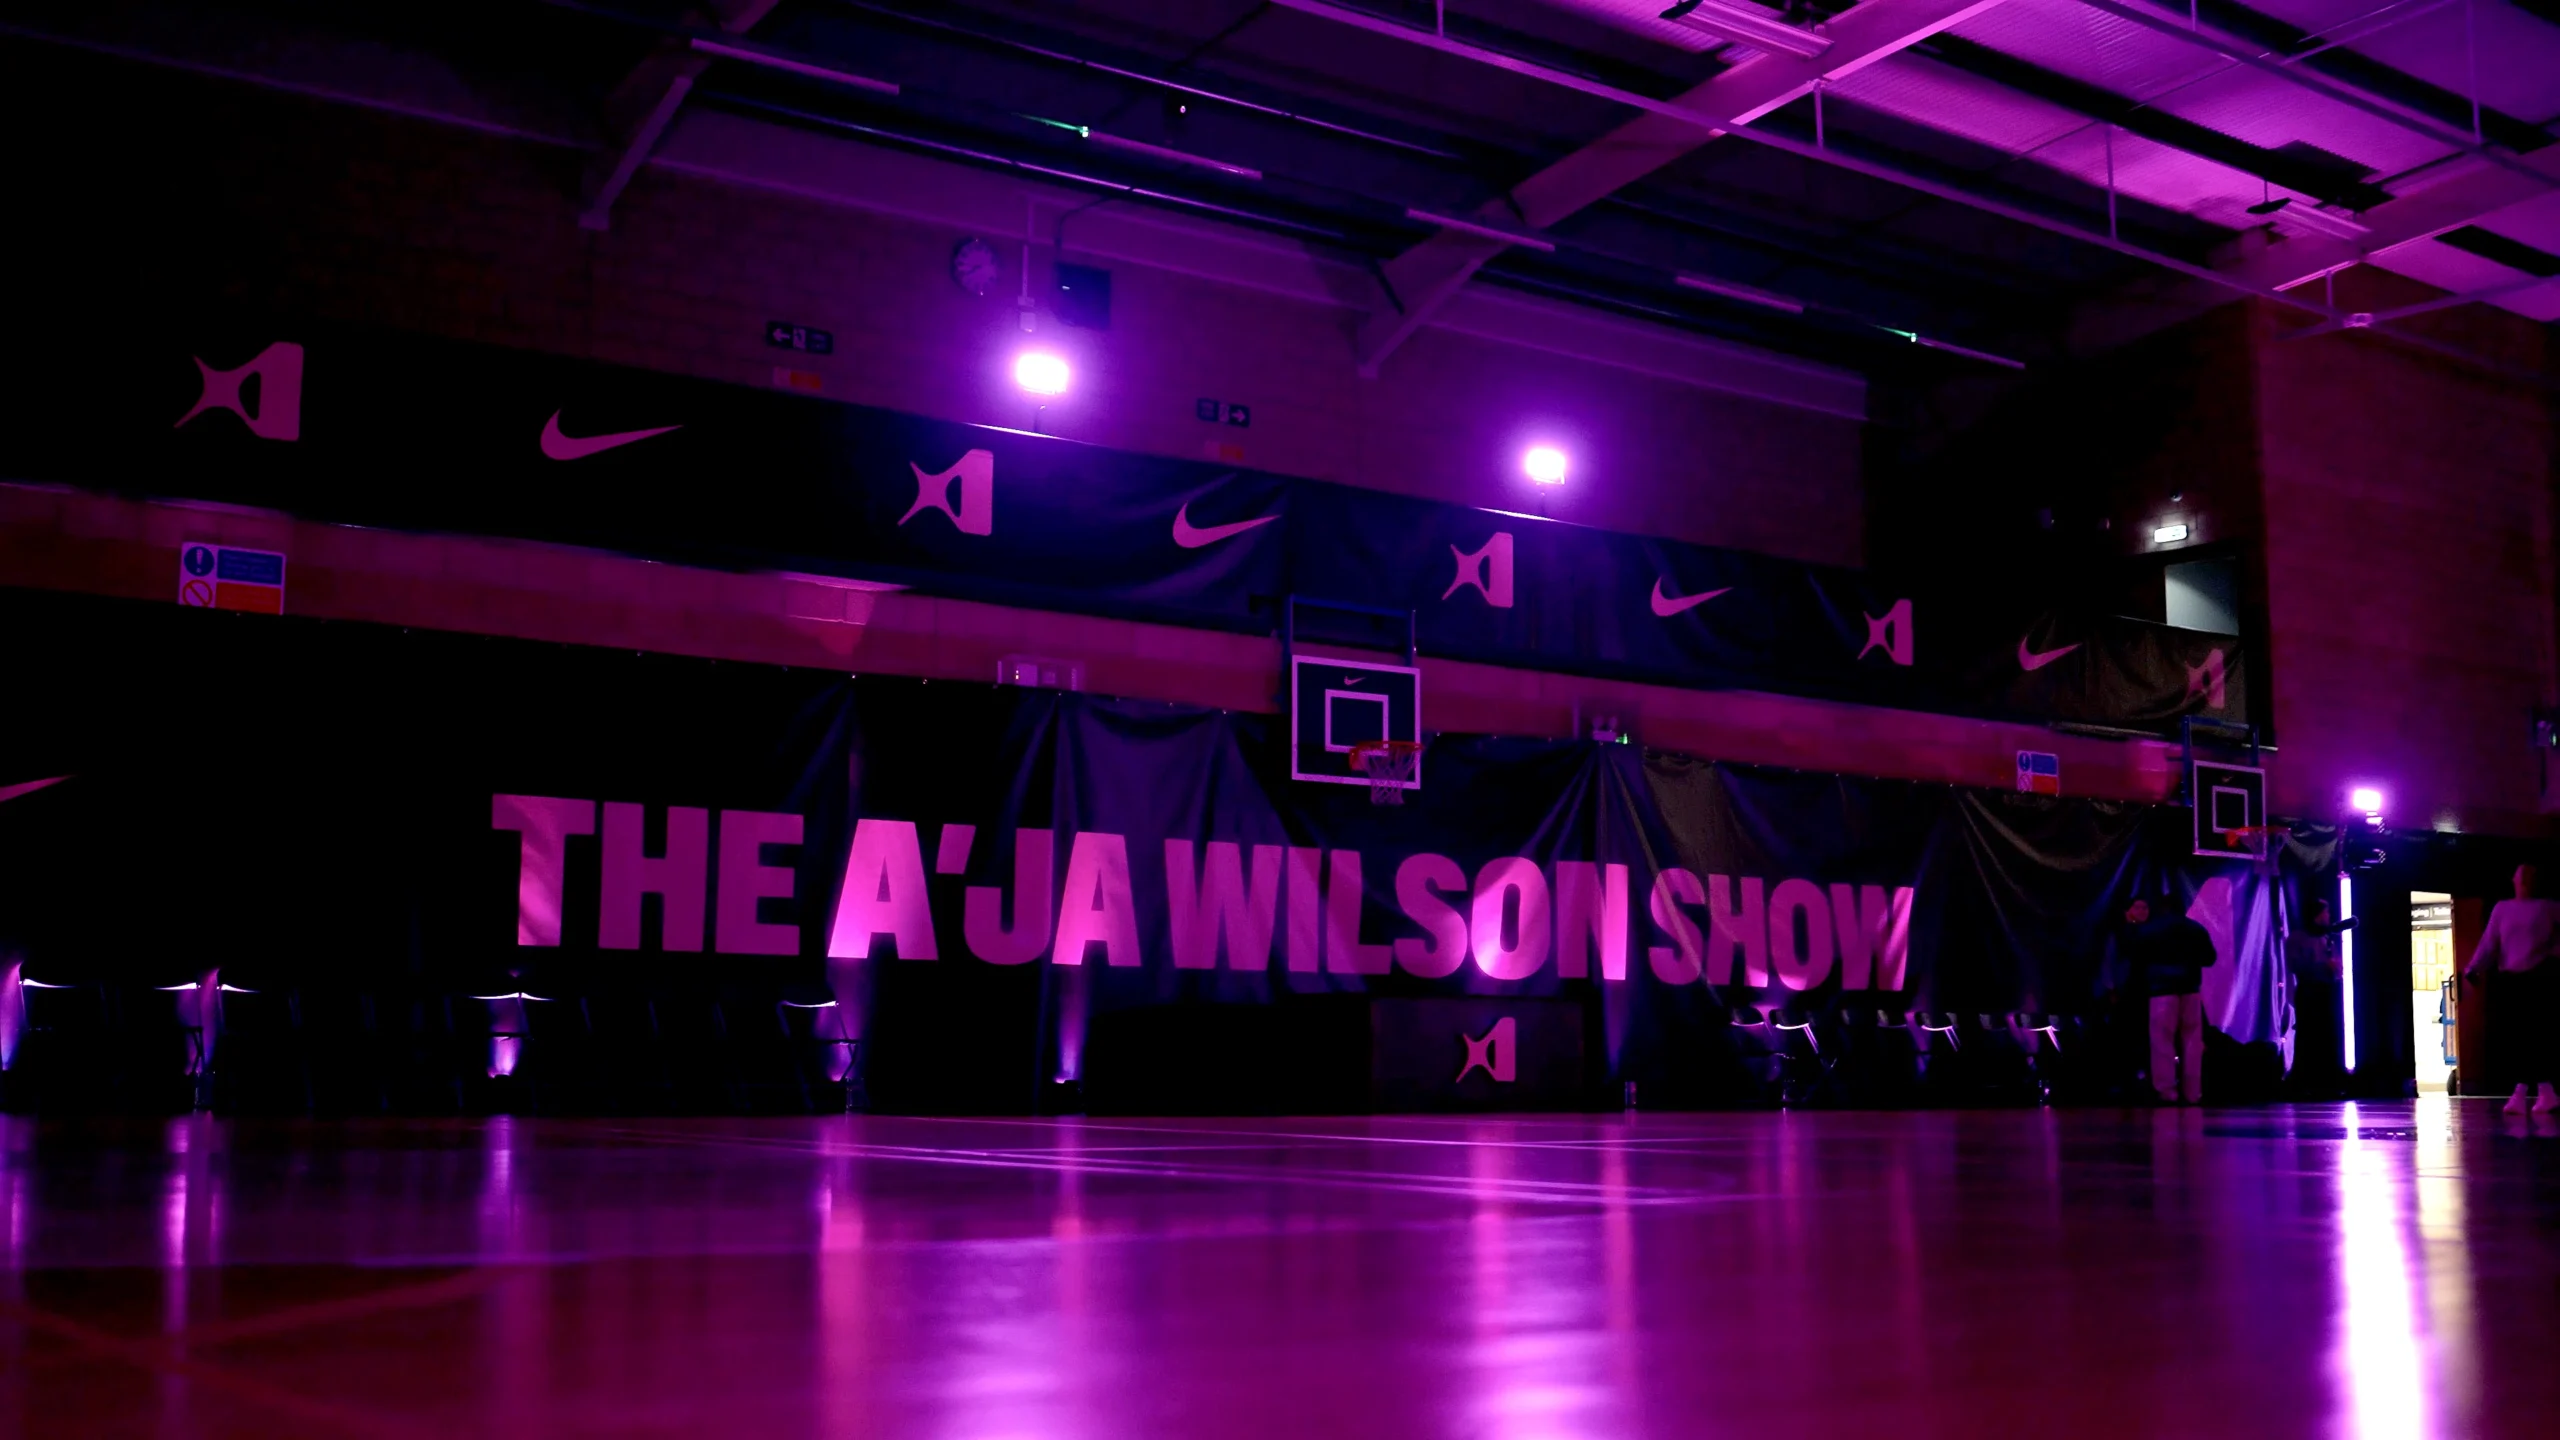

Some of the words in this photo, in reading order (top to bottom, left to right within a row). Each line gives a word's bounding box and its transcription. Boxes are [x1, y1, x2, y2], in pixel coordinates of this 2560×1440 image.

[492, 793, 805, 956] THE
[827, 818, 1142, 968] A'JA
[1164, 838, 1630, 981] WILSON
[1648, 867, 1915, 992] SHOW
